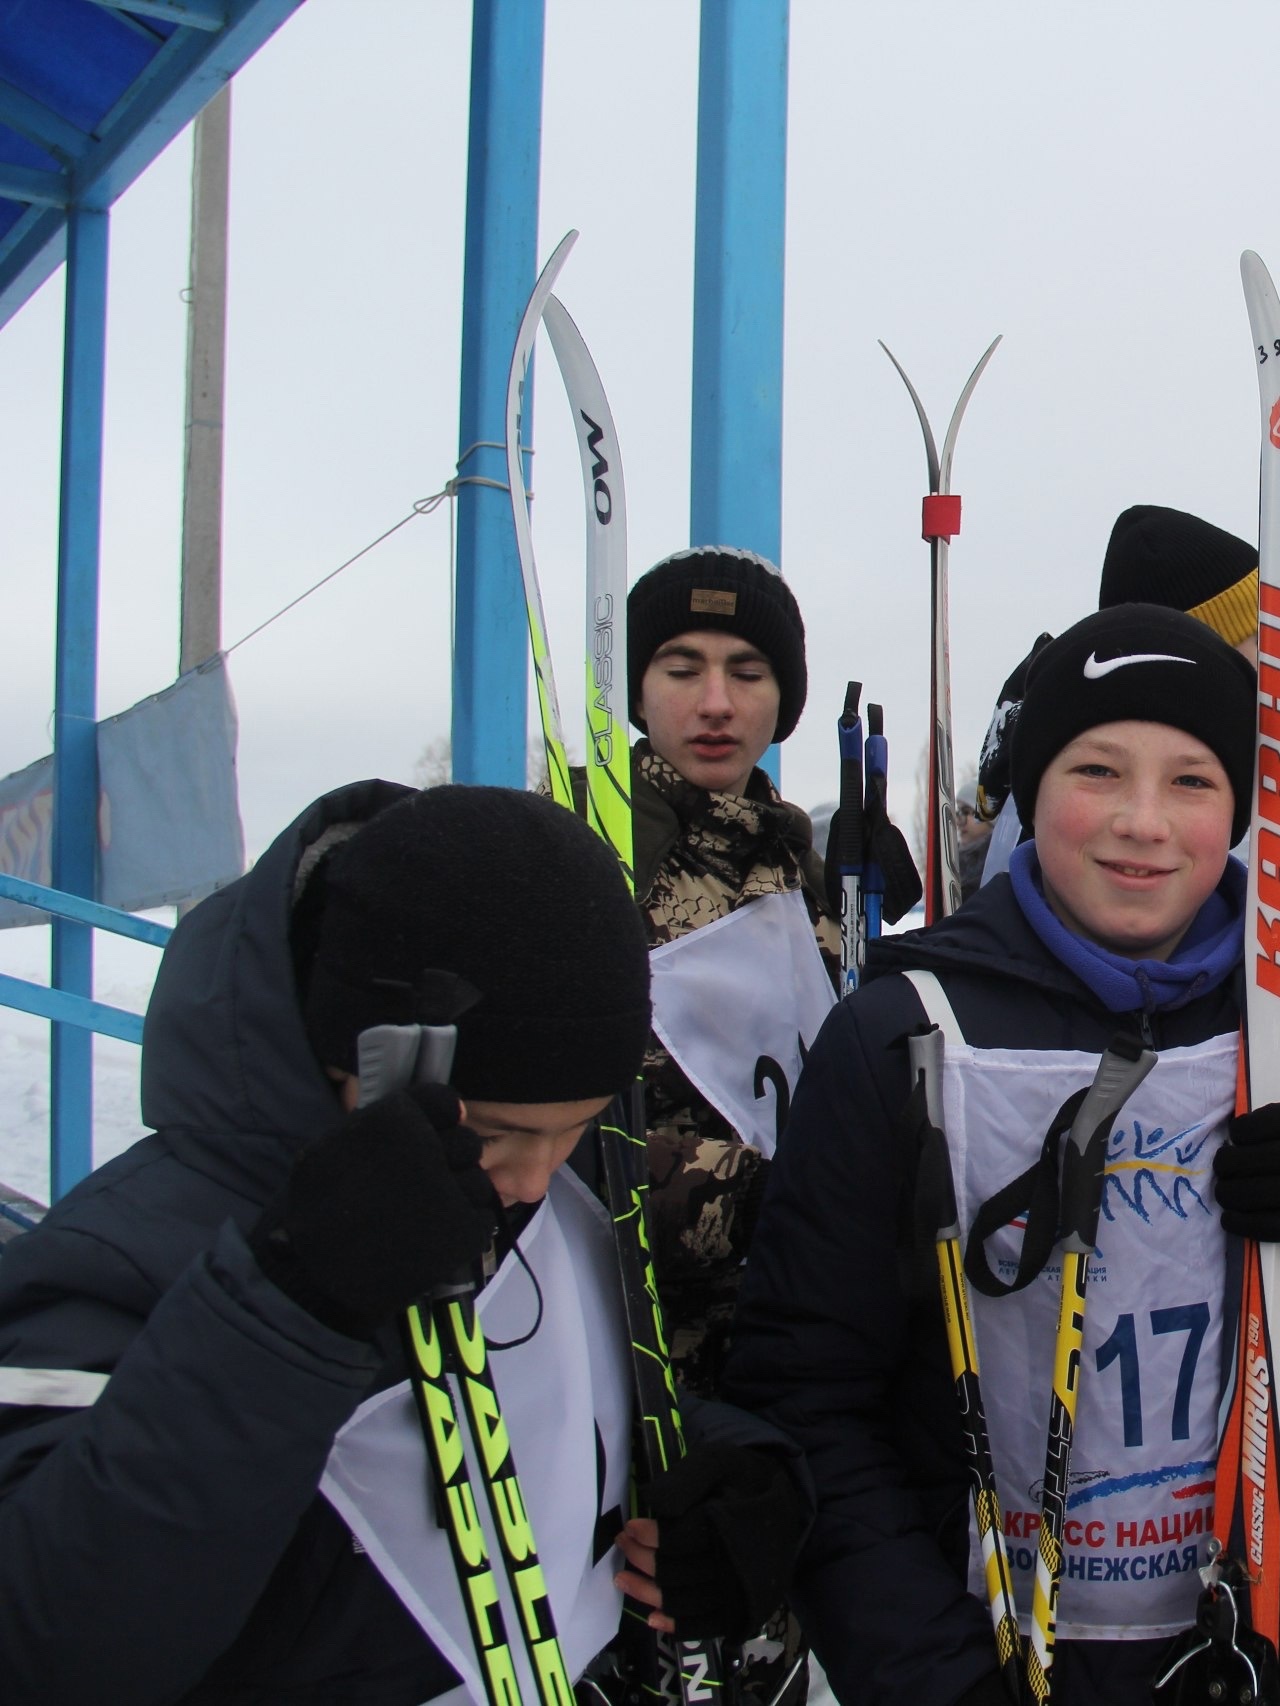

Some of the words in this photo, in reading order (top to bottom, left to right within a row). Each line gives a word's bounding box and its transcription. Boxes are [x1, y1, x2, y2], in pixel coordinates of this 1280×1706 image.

[593, 593, 614, 768] CLASSIC
[1095, 1301, 1211, 1448] 17
[1248, 1312, 1261, 1347] 190
[1241, 1348, 1271, 1491] MIRUS
[1004, 1510, 1106, 1548] КРСС
[1250, 1486, 1266, 1567] CLASSIC
